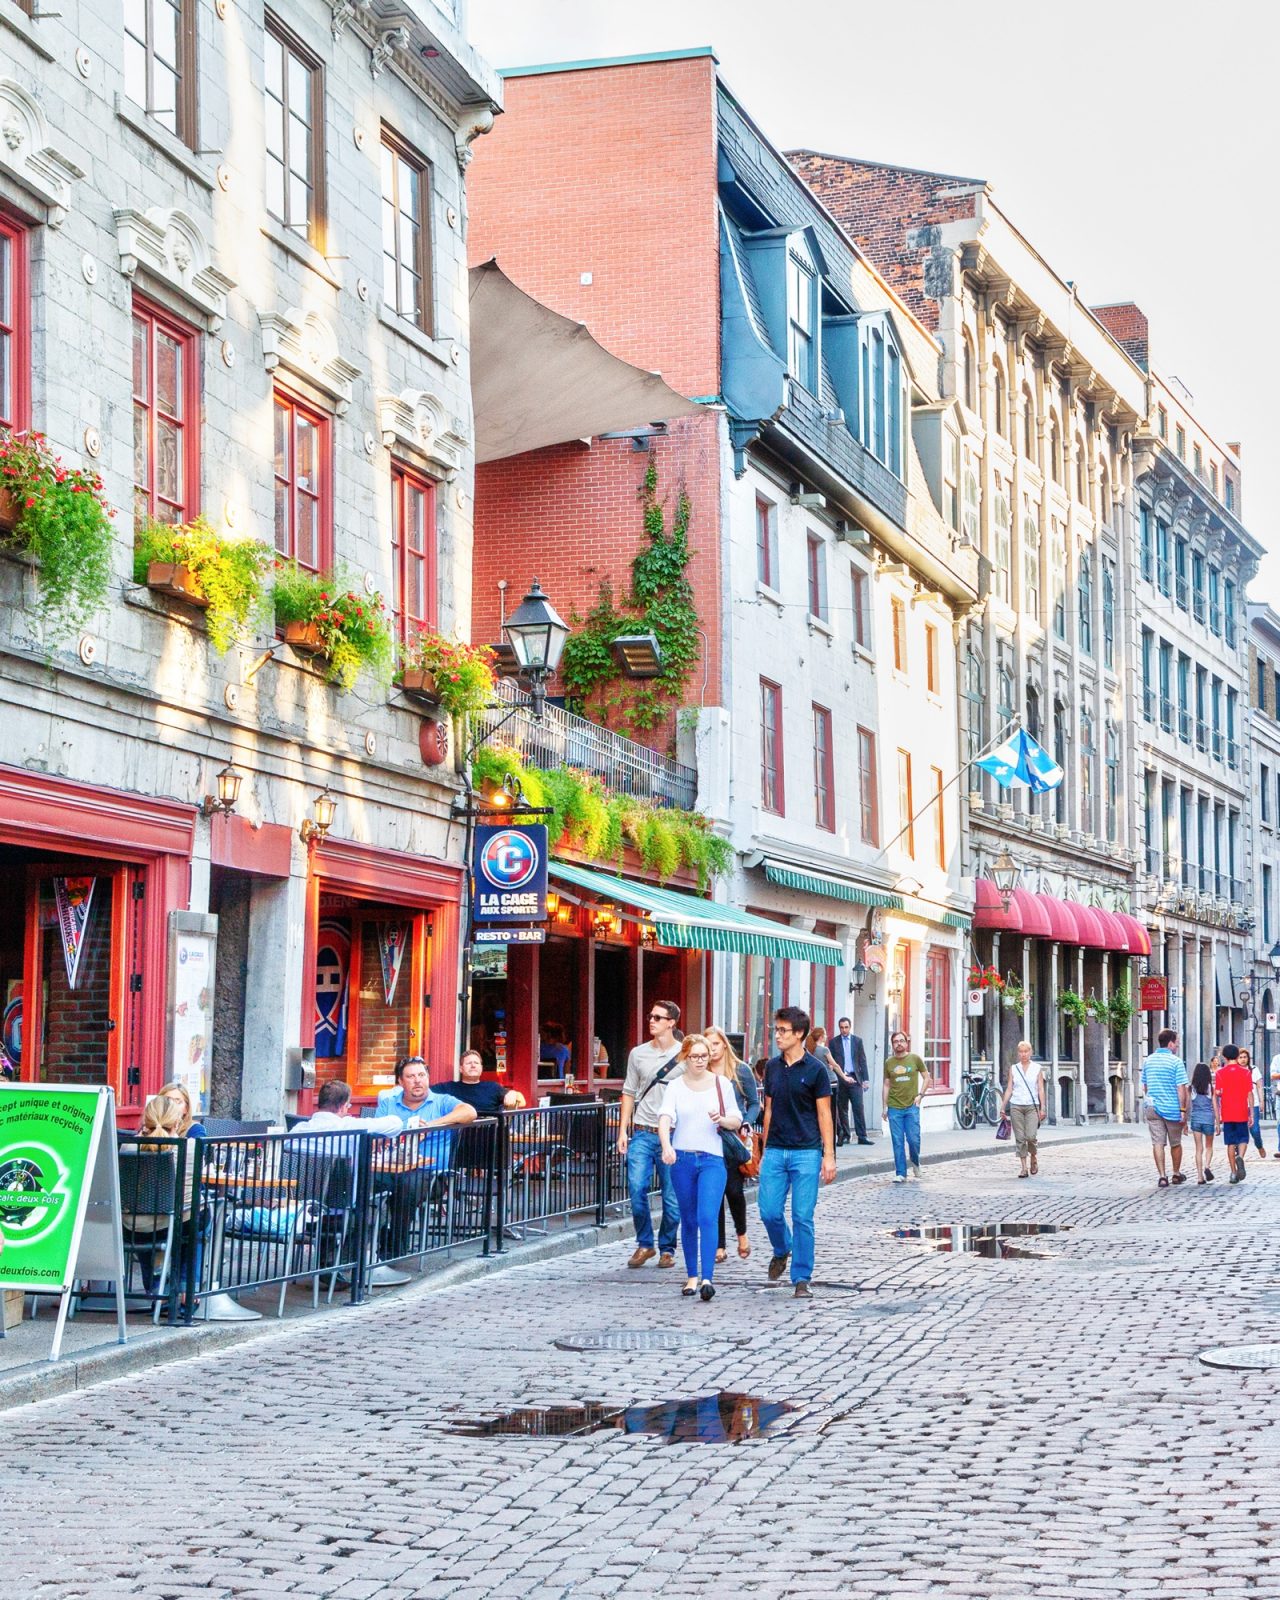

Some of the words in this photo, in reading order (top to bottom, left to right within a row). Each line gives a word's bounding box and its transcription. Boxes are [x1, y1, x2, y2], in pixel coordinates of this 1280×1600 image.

[496, 845, 523, 874] C
[480, 893, 500, 906] LA
[500, 893, 538, 906] CAGE
[480, 906, 500, 915] AUX
[500, 906, 538, 914] SPORTS
[476, 932, 511, 941] RESTO
[518, 932, 542, 940] BAR
[20, 1098, 49, 1108] unique
[52, 1101, 61, 1109] et
[62, 1103, 95, 1125] original
[16, 1195, 39, 1203] deux
[41, 1196, 59, 1205] fois
